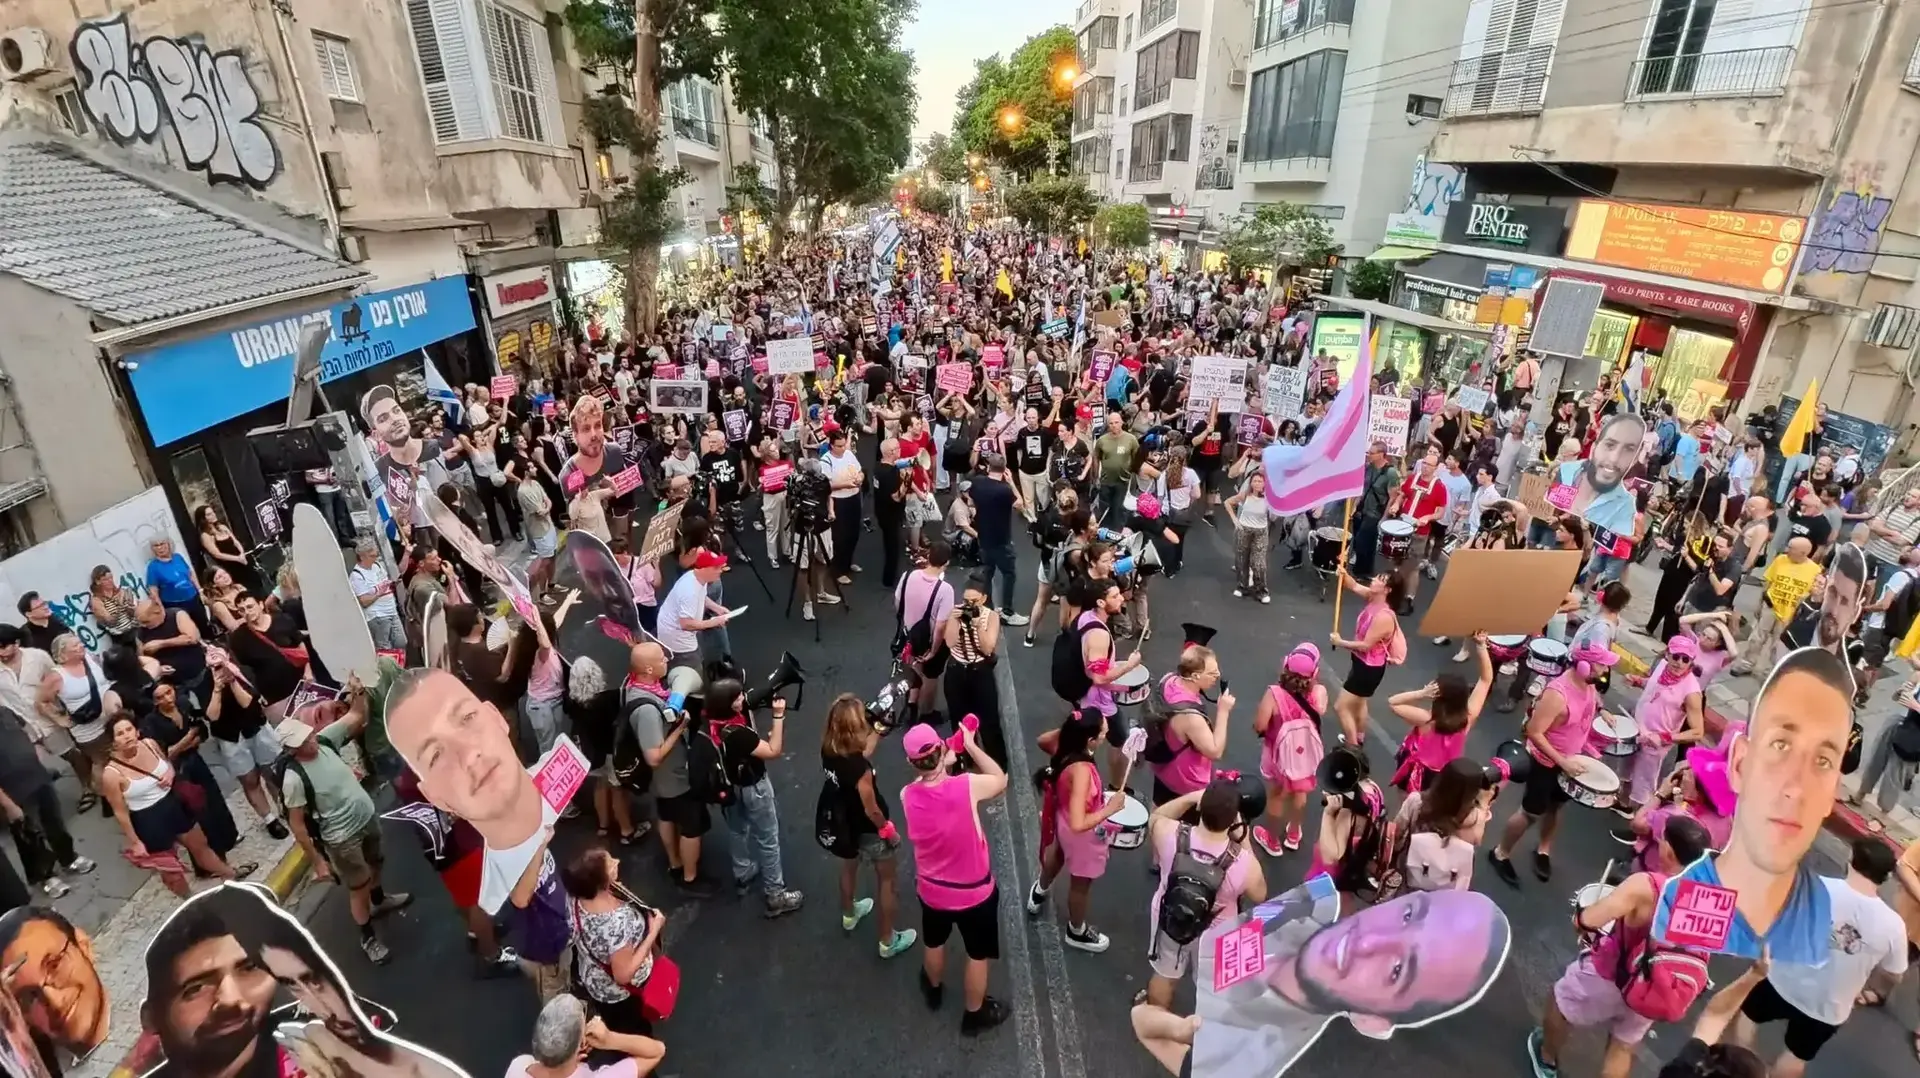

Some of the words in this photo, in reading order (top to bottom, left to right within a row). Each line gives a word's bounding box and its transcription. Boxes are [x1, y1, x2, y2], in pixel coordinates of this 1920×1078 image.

[1466, 203, 1511, 234] PRO
[1472, 221, 1527, 240] CENTER
[1406, 280, 1449, 297] professional
[1449, 287, 1467, 300] hair
[1617, 284, 1635, 295] OLD
[1635, 288, 1666, 302] PRINTS
[369, 299, 394, 328] פט
[393, 290, 428, 328] אורבן
[1674, 295, 1701, 308] RARE
[1701, 299, 1736, 314] BOOKS
[231, 318, 300, 368] URBAN
[373, 339, 396, 361] הבית
[1324, 335, 1354, 346] pumba
[343, 344, 373, 372] לחיות
[651, 527, 671, 546] רצח
[545, 747, 570, 782] עדיין
[553, 763, 581, 802] בעזה.
[1693, 888, 1733, 911] עדיין
[1675, 913, 1725, 937] בעזה.
[1241, 934, 1259, 973] עדיין
